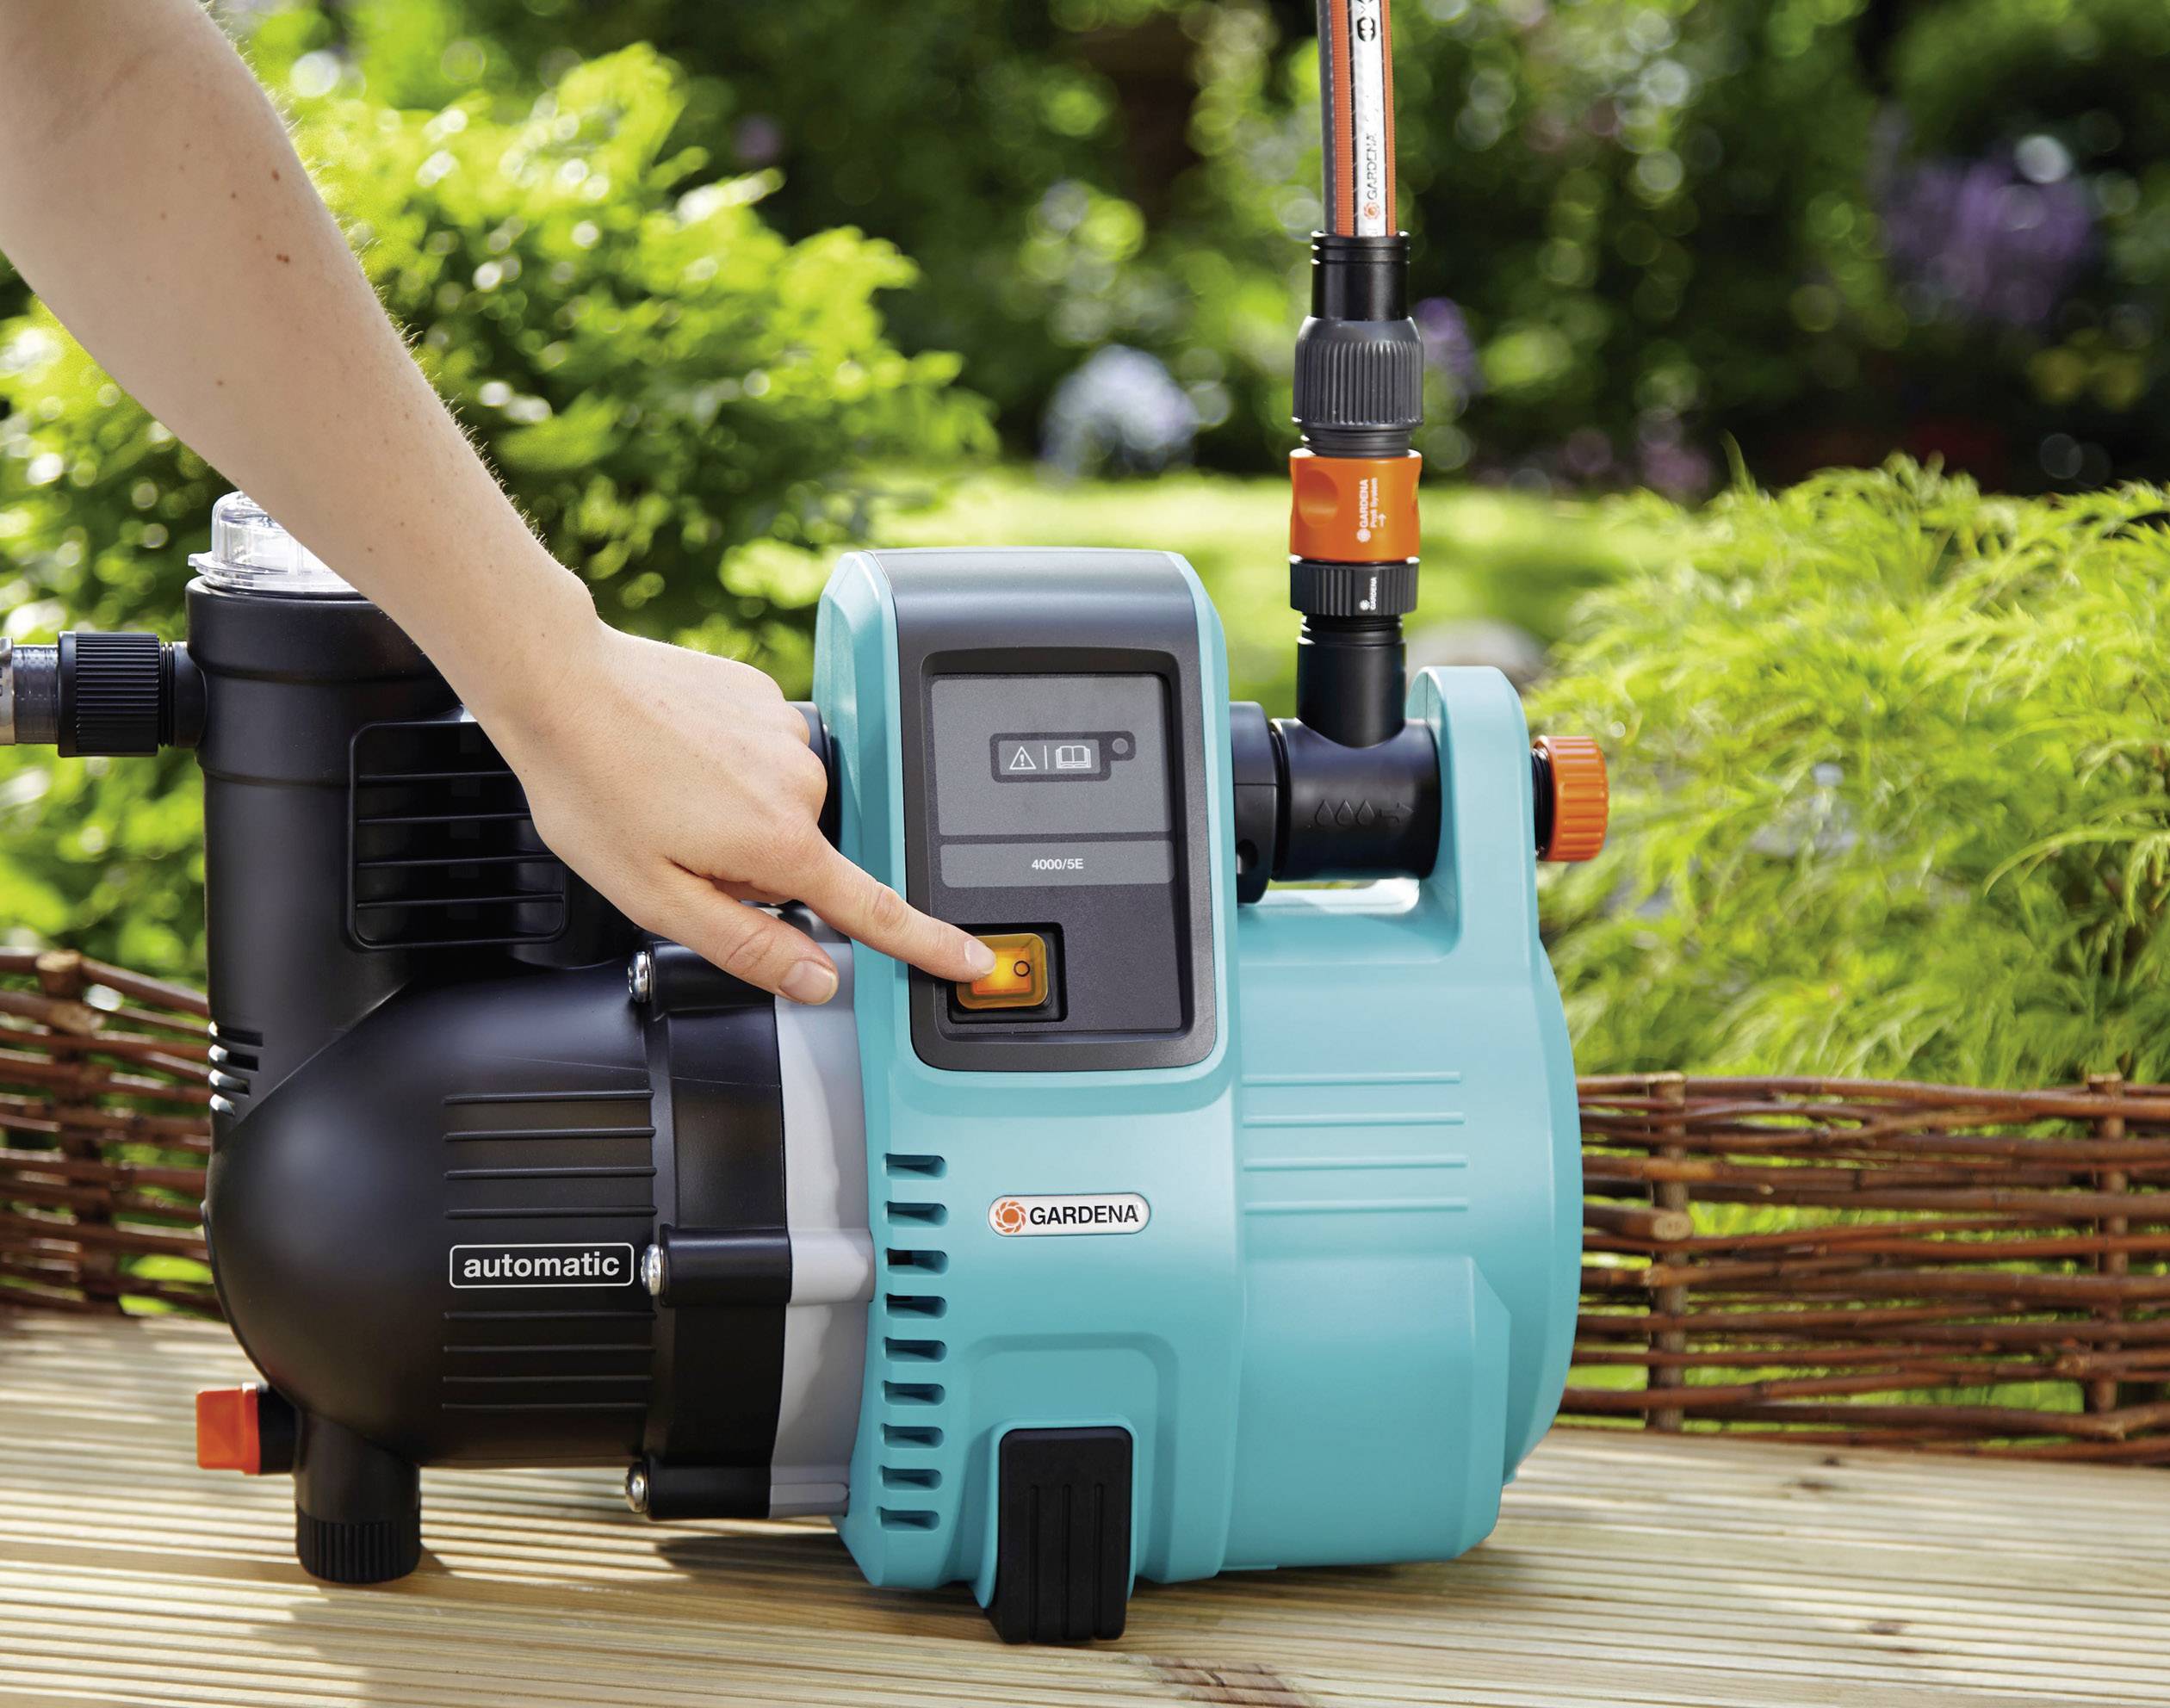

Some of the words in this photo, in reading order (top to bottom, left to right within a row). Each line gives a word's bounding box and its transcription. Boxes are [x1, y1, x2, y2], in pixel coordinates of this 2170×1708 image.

[1366, 133, 1378, 201] GARDENA
[1359, 479, 1369, 528] GARDENA
[1369, 577, 1378, 610] GARDENA
[1032, 858, 1084, 870] 4000/5E
[1029, 1204, 1139, 1225] GARDENA
[462, 1251, 620, 1278] automatic
